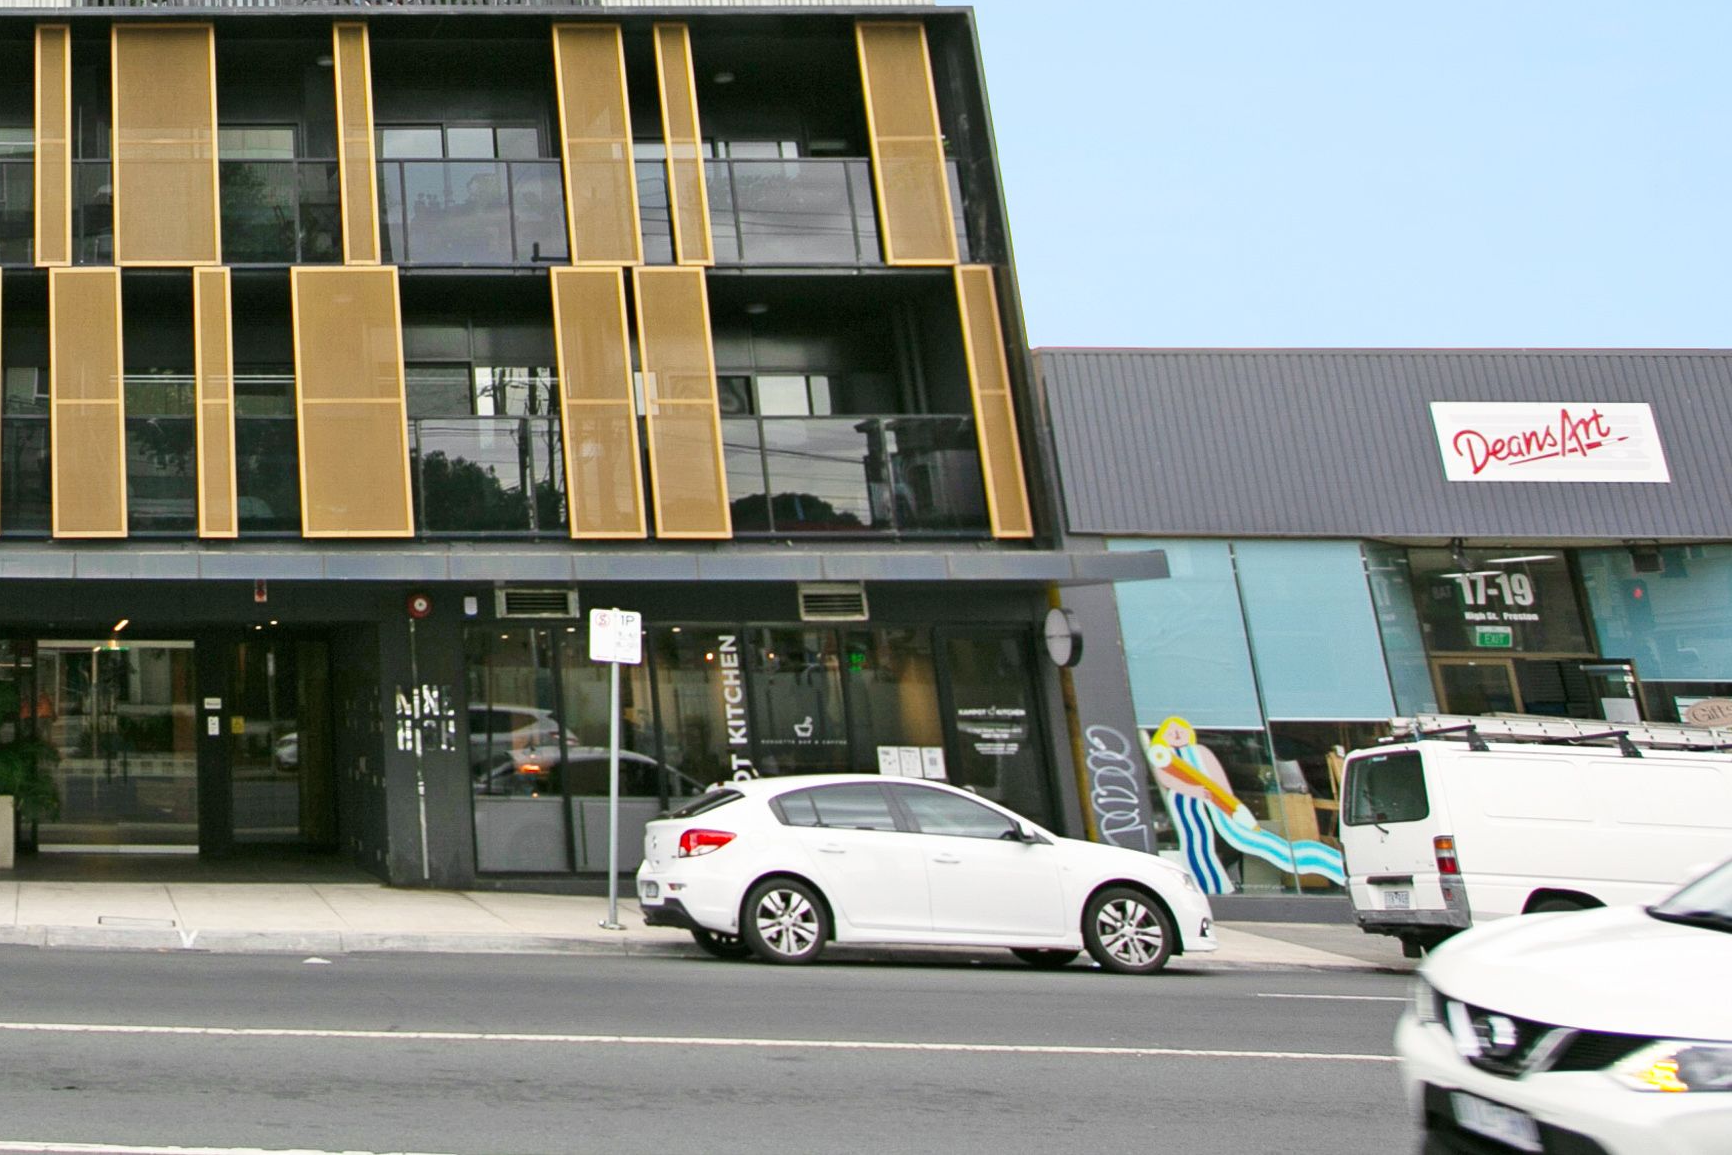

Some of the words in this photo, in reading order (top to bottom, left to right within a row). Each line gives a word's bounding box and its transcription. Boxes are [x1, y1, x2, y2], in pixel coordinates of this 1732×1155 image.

[1455, 573, 1535, 606] 17-19
[1503, 612, 1539, 621] Preston
[1484, 633, 1505, 645] EXIT
[718, 635, 748, 744] KITCHEN
